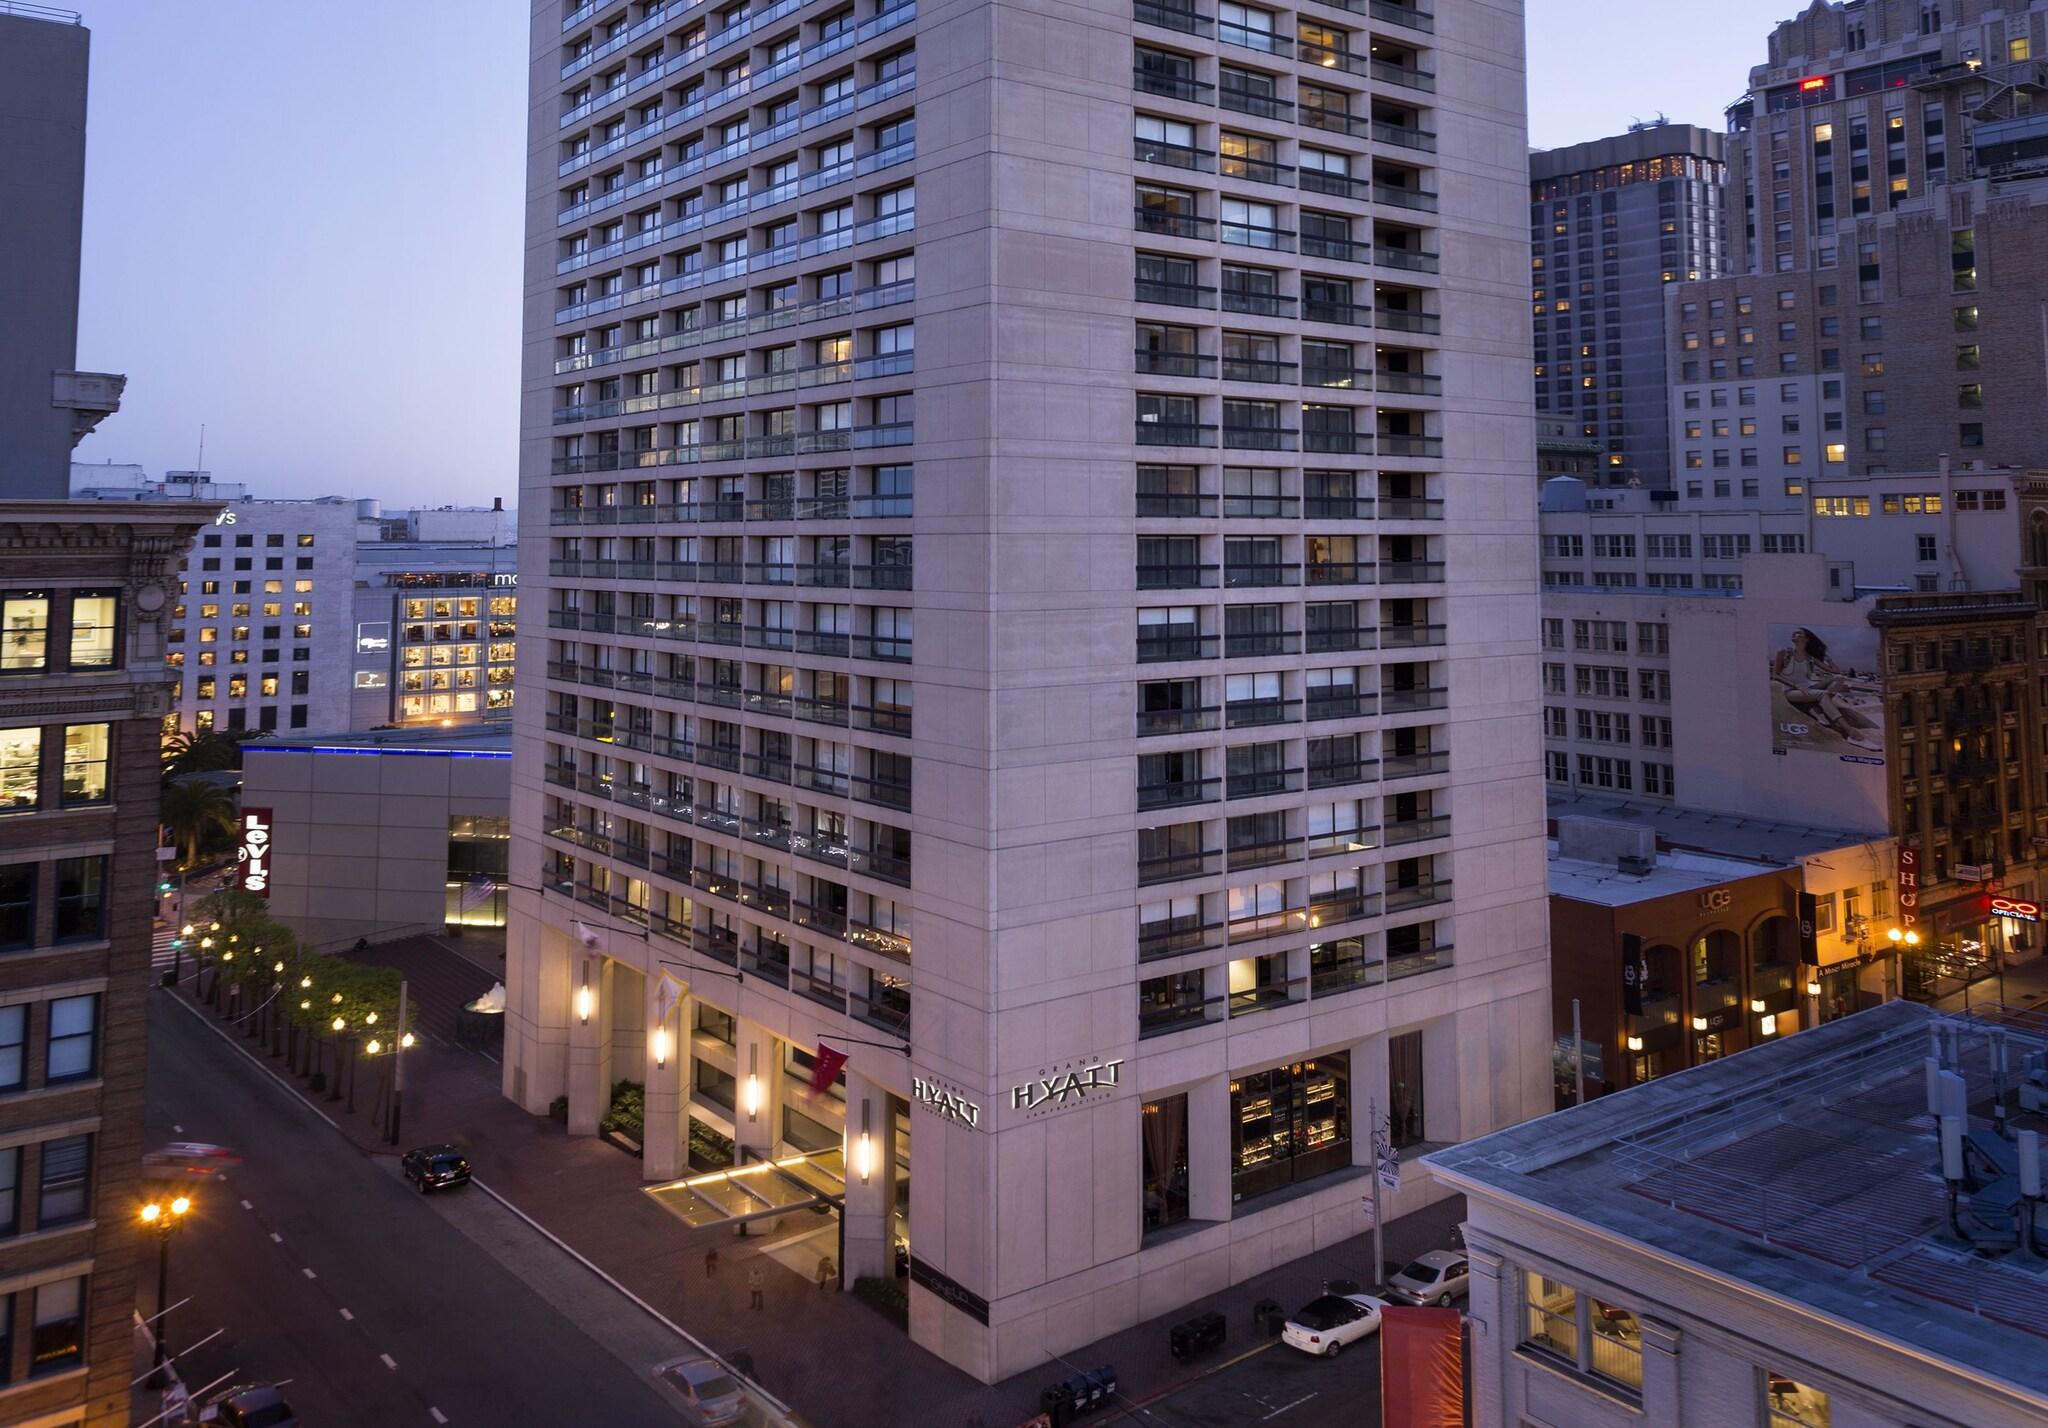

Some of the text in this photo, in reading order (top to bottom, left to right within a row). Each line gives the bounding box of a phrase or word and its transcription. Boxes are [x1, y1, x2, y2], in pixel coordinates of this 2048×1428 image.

[1012, 1059, 1125, 1110] HYATT
[1038, 1055, 1099, 1076] GRAND
[912, 1077, 980, 1127] HYATT
